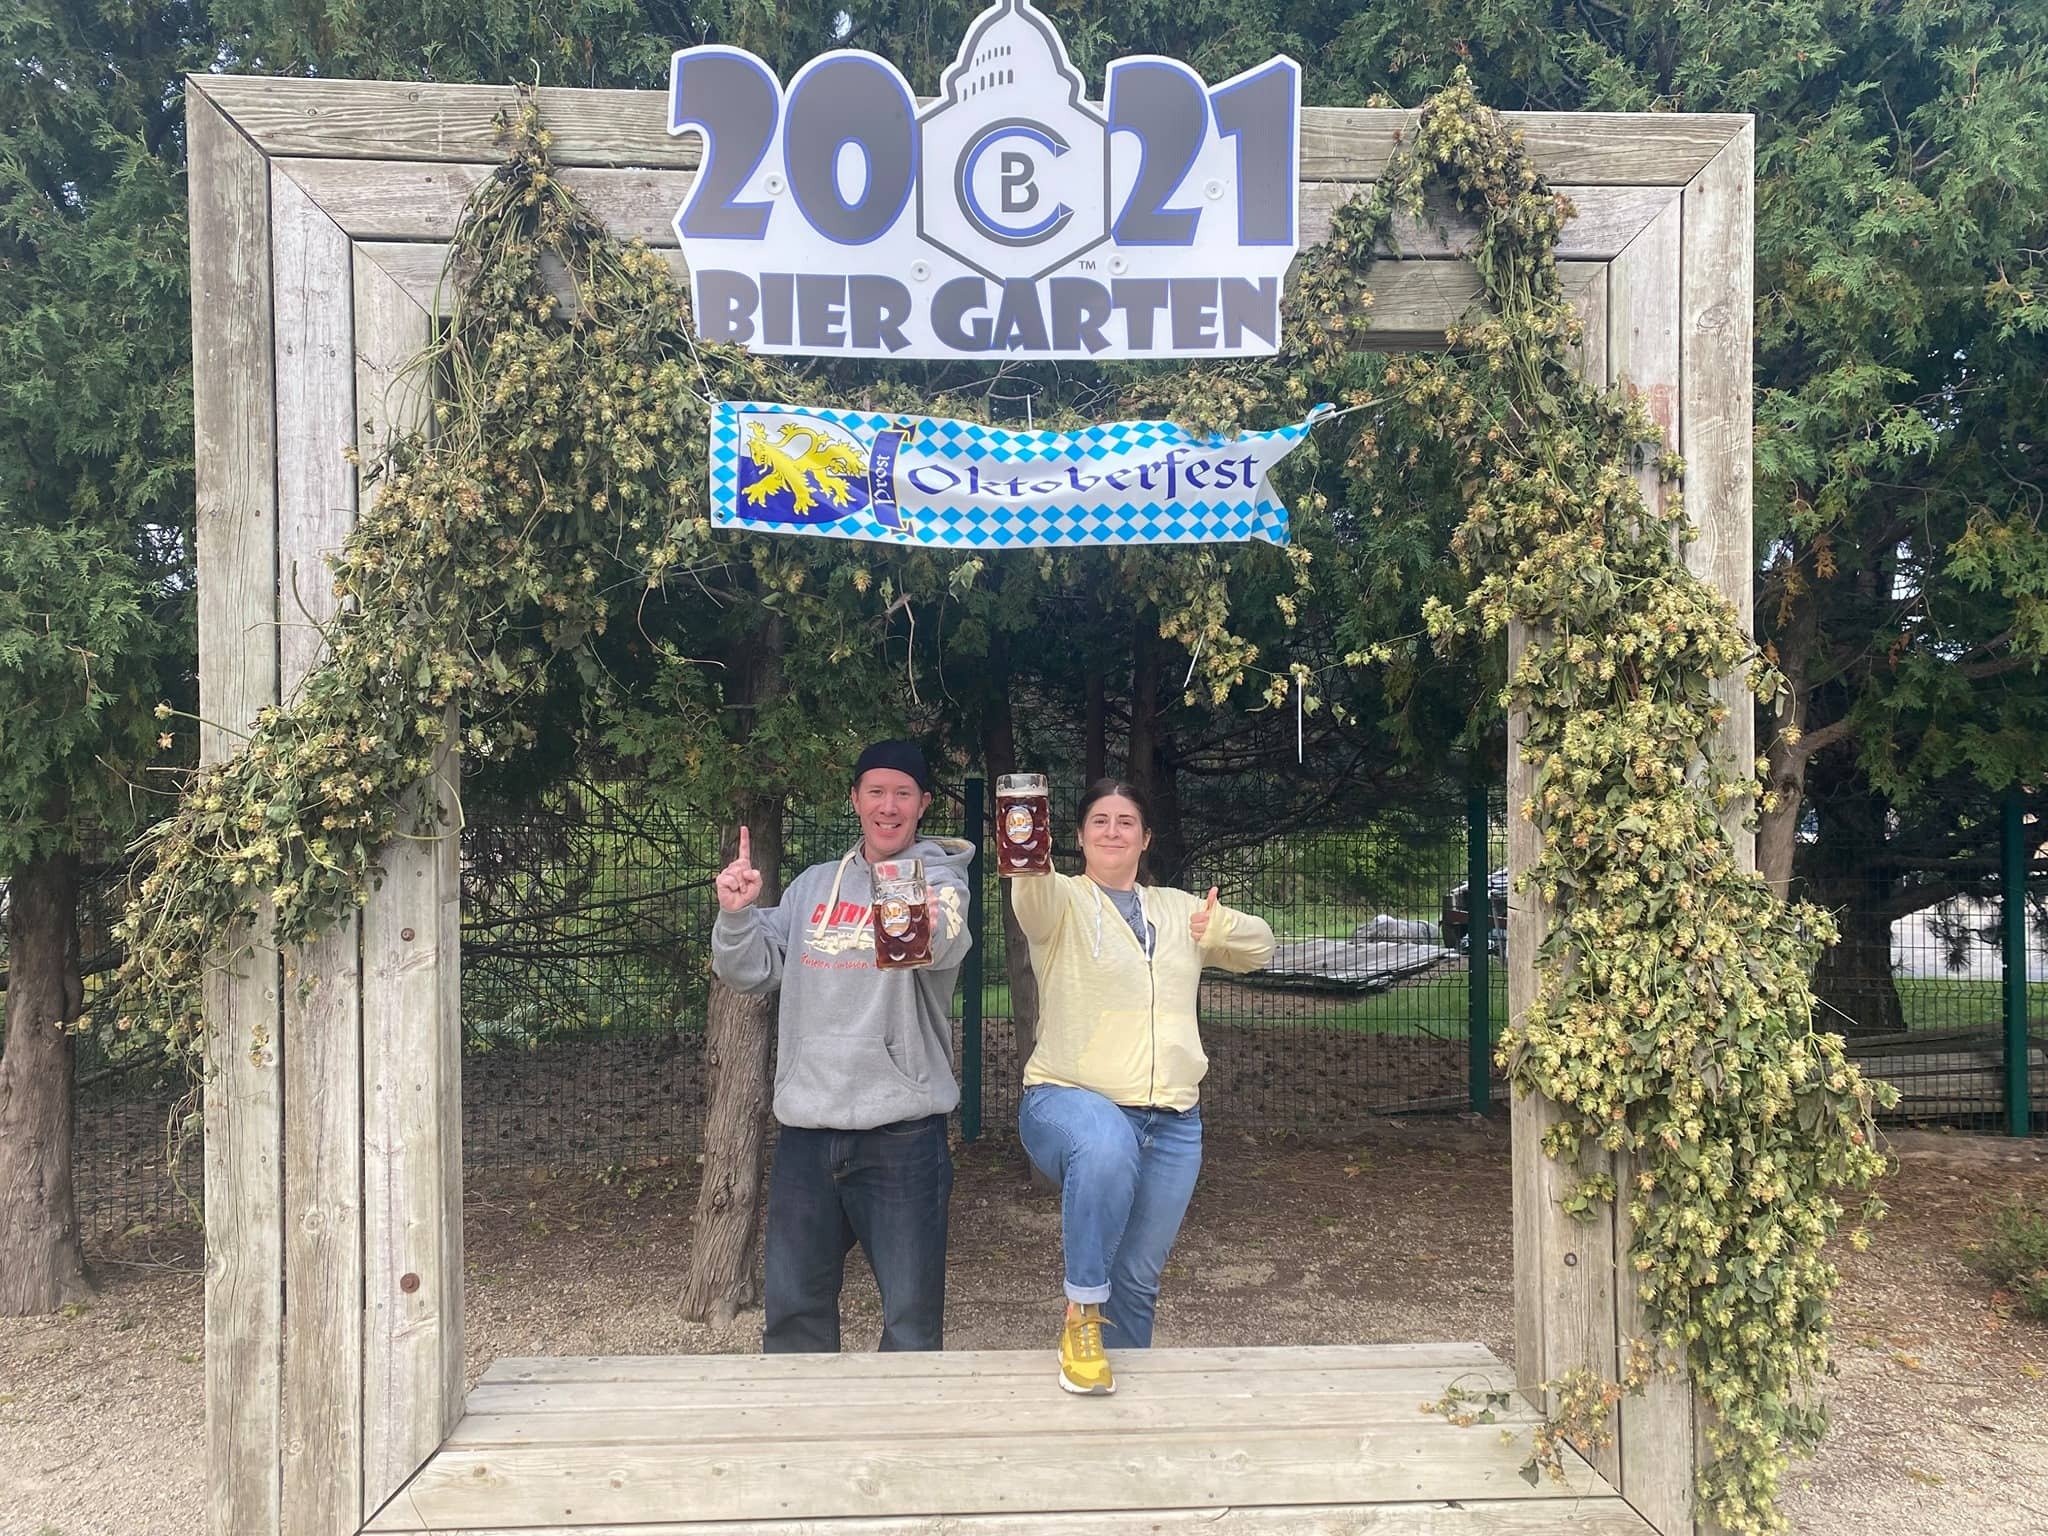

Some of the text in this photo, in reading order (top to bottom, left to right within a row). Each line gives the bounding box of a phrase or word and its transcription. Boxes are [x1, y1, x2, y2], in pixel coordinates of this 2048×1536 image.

[696, 269, 1277, 355] BIER GARTEN
[907, 448, 1260, 500] Oktoberfest
